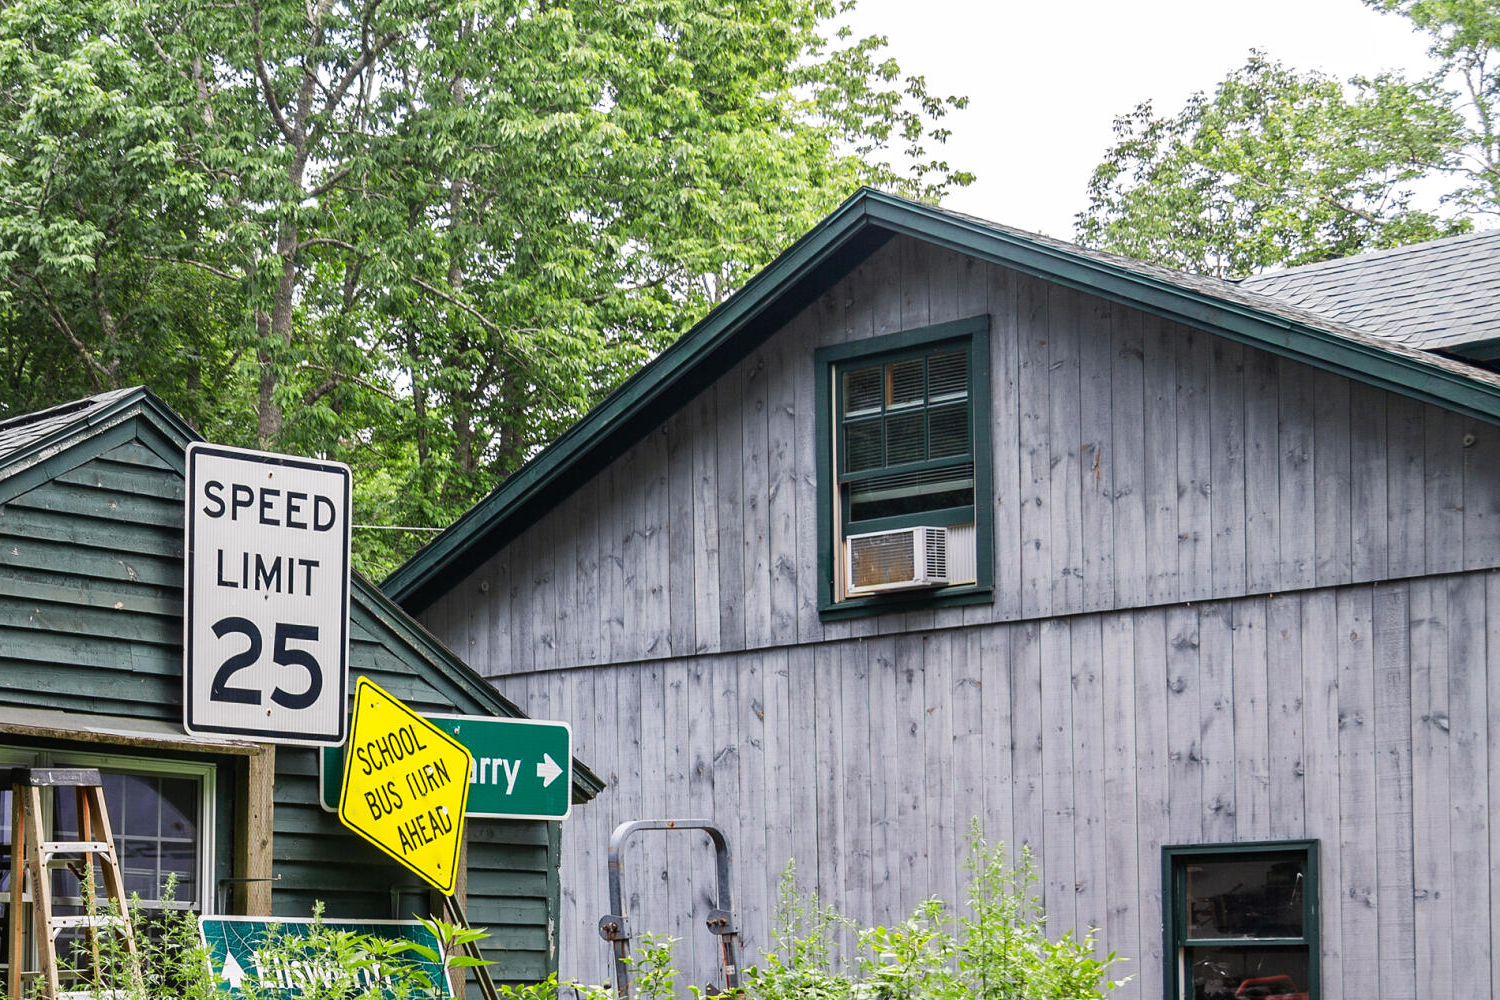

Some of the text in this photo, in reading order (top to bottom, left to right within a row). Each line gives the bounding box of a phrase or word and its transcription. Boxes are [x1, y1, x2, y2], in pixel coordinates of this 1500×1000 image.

[202, 480, 336, 532] SPEED
[217, 549, 320, 596] LIMIT
[210, 616, 322, 709] 25
[357, 724, 427, 775] SCHOOL
[364, 758, 451, 821] BUS TURN
[397, 806, 452, 855] AHEAD
